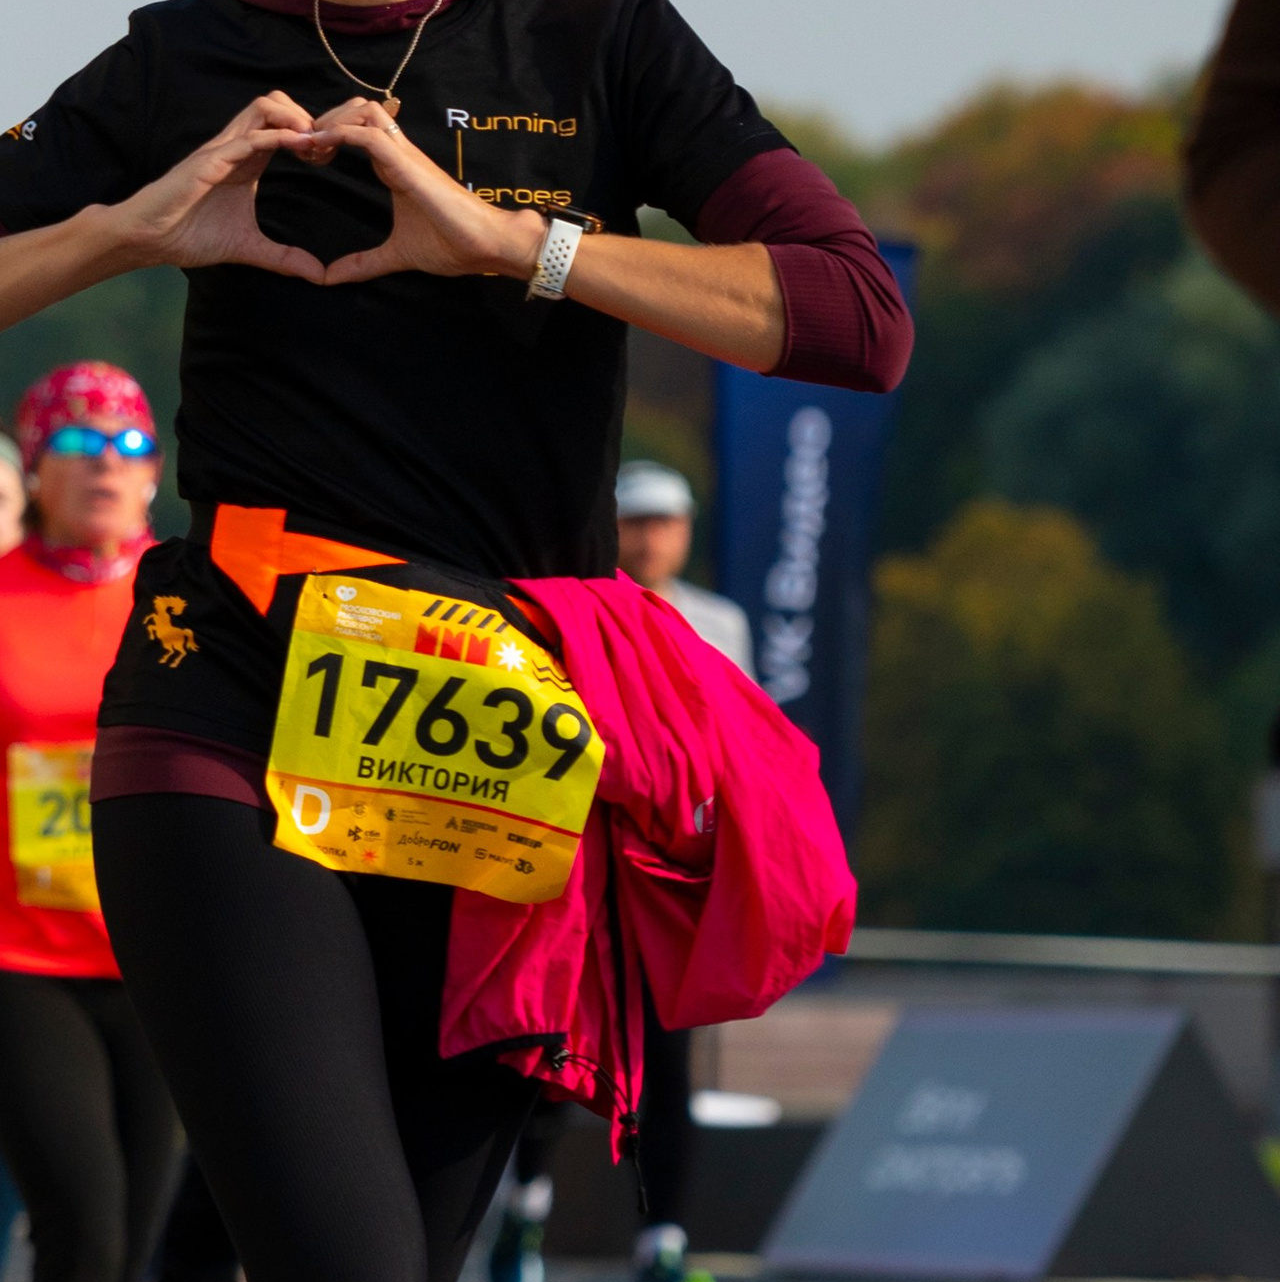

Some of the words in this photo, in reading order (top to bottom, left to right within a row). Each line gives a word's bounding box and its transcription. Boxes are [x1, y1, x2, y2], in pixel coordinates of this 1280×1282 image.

[446, 108, 578, 137] Running
[467, 182, 572, 206] eroes
[305, 651, 593, 782] 17639
[356, 755, 512, 804] ВИКТОРИЯ
[291, 783, 332, 835] D
